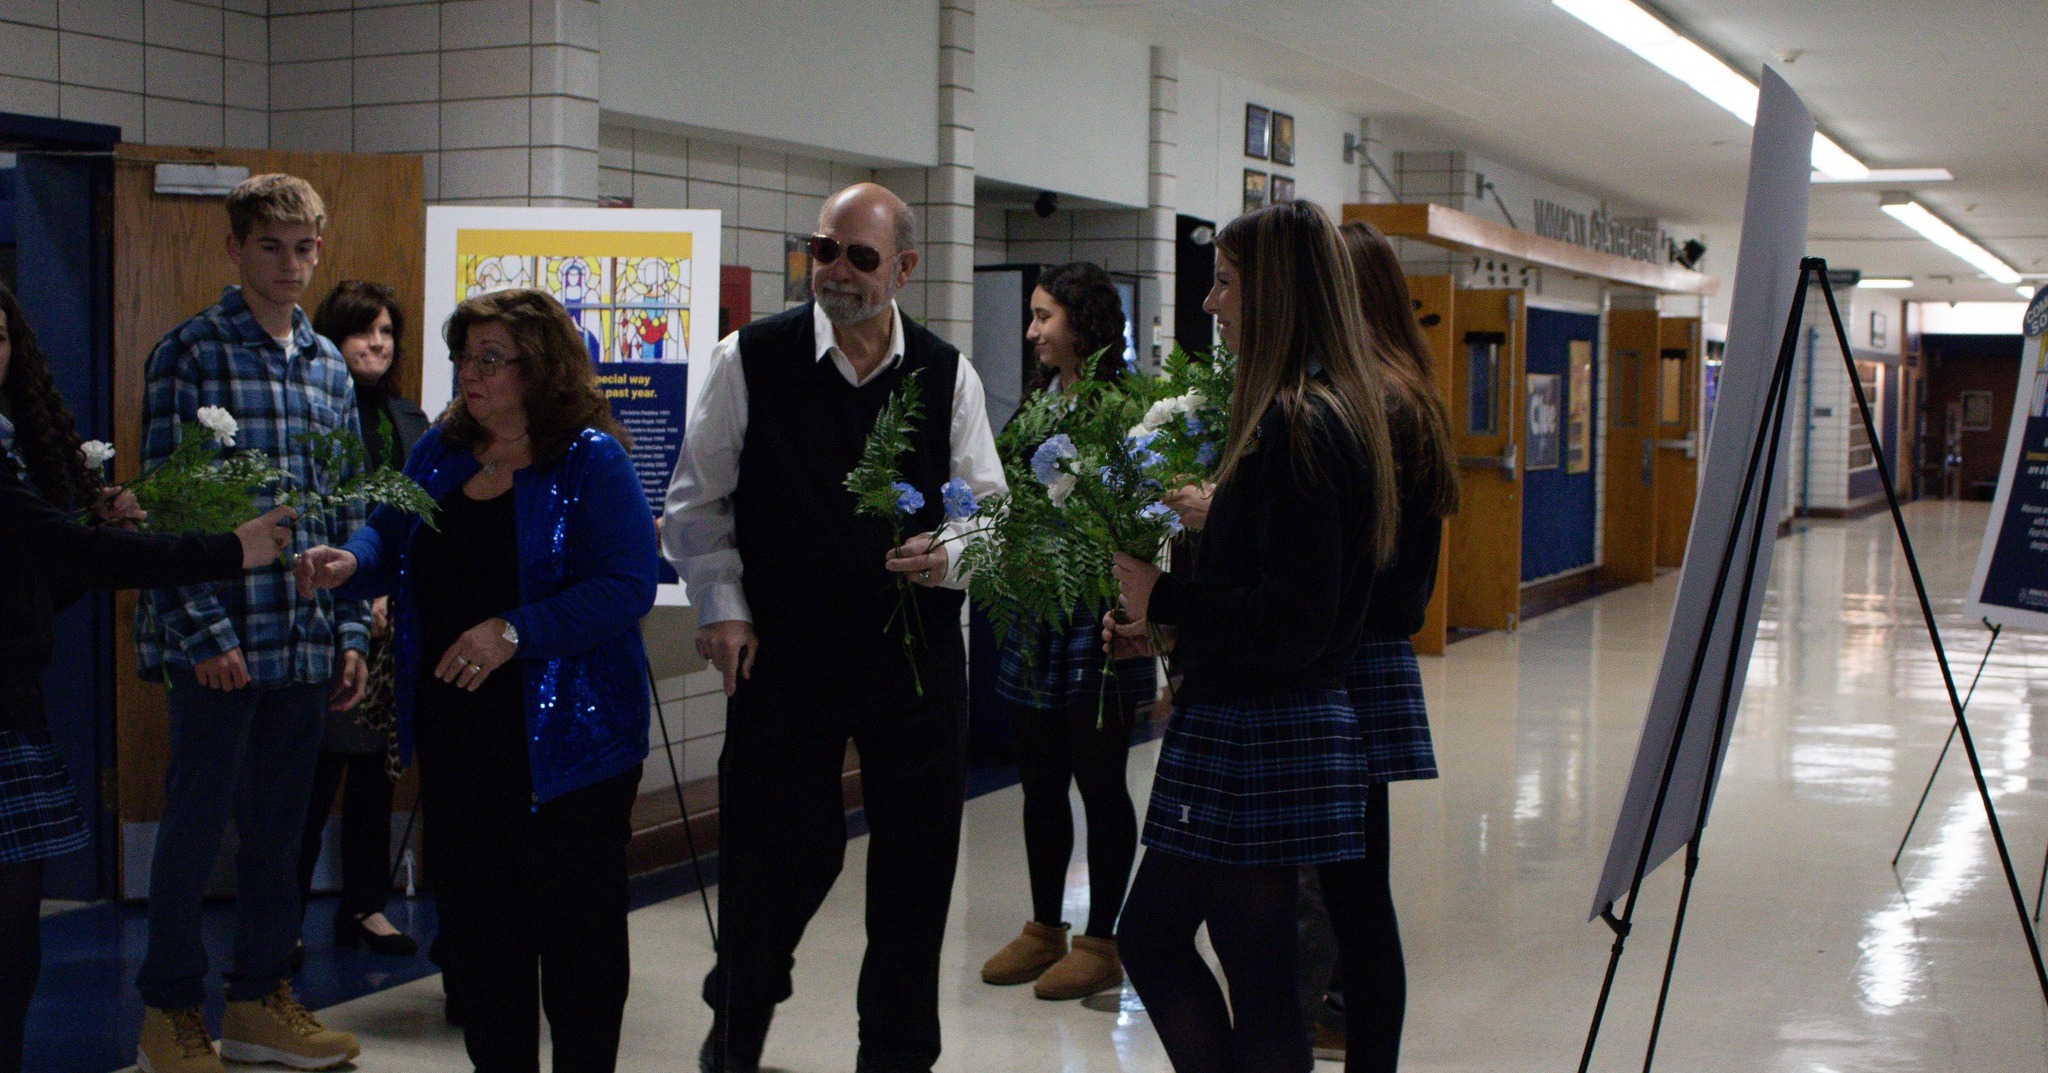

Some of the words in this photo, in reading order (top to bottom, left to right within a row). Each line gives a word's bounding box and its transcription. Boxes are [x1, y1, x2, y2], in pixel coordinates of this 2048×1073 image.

[594, 373, 627, 386] pecial
[629, 375, 651, 387] way
[605, 388, 629, 400] past
[631, 389, 658, 401] year.
[1178, 804, 1192, 824] I
